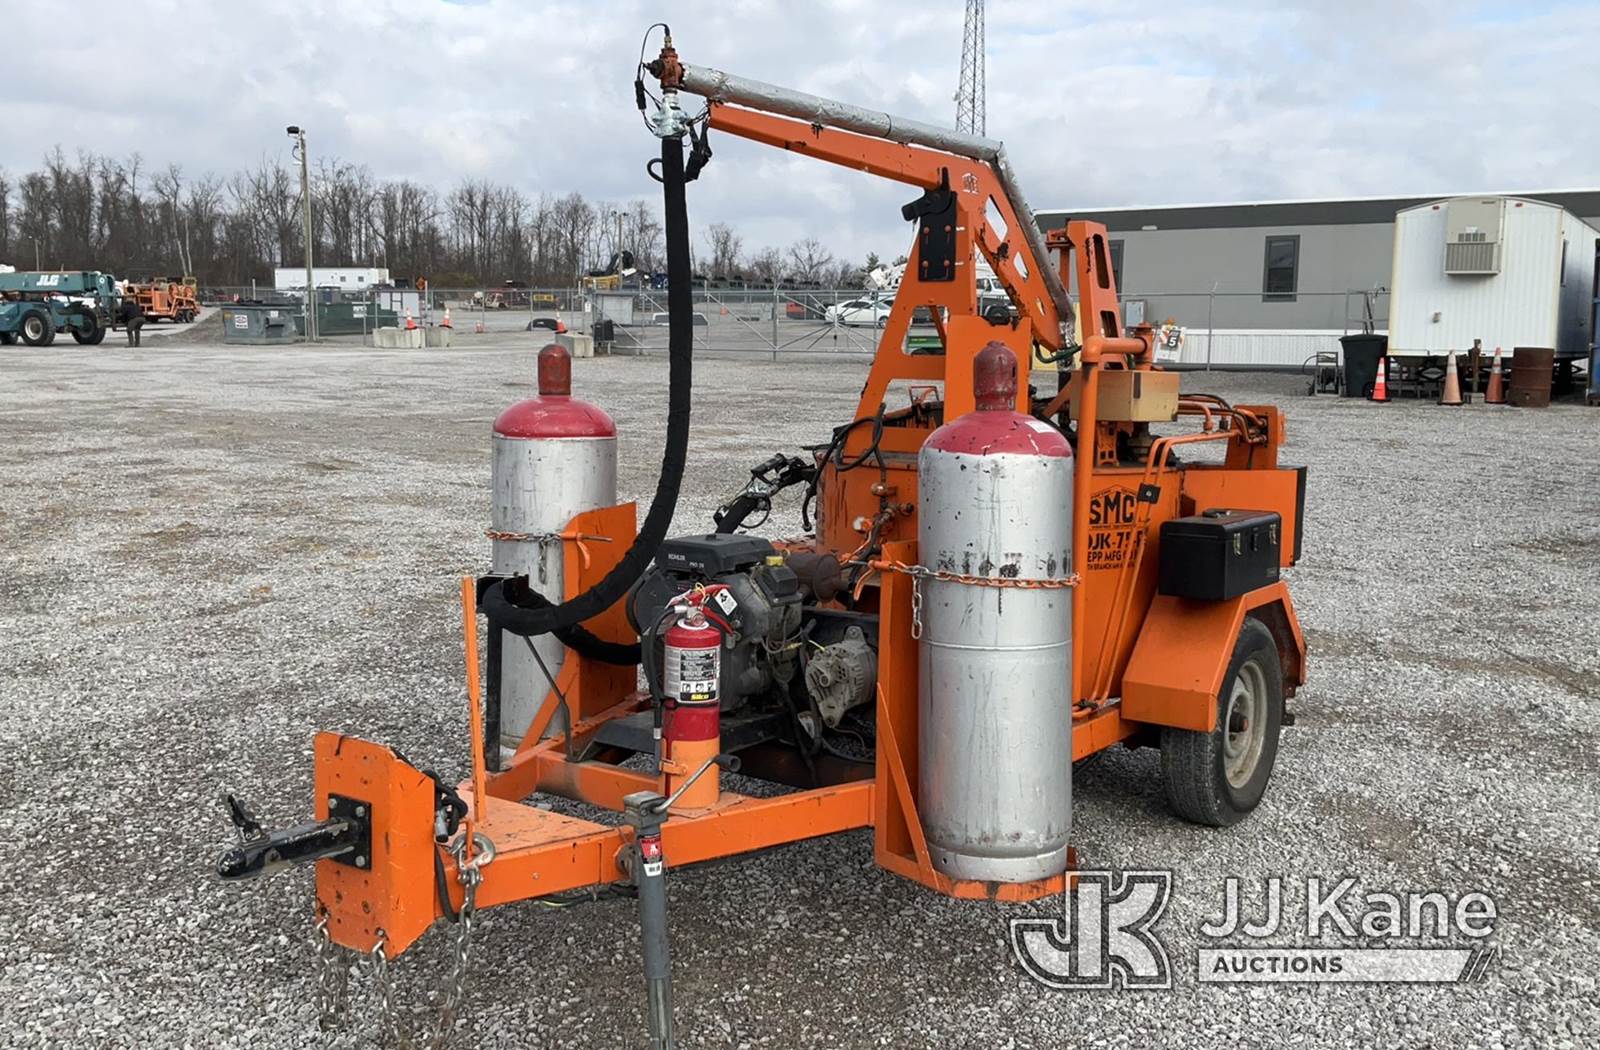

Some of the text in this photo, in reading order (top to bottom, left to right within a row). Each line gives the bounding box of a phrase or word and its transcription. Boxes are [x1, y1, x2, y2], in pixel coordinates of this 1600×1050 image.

[36, 274, 60, 287] JLG
[1168, 336, 1177, 347] 5
[1089, 491, 1135, 525] SMC
[668, 553, 686, 561] KOHLER
